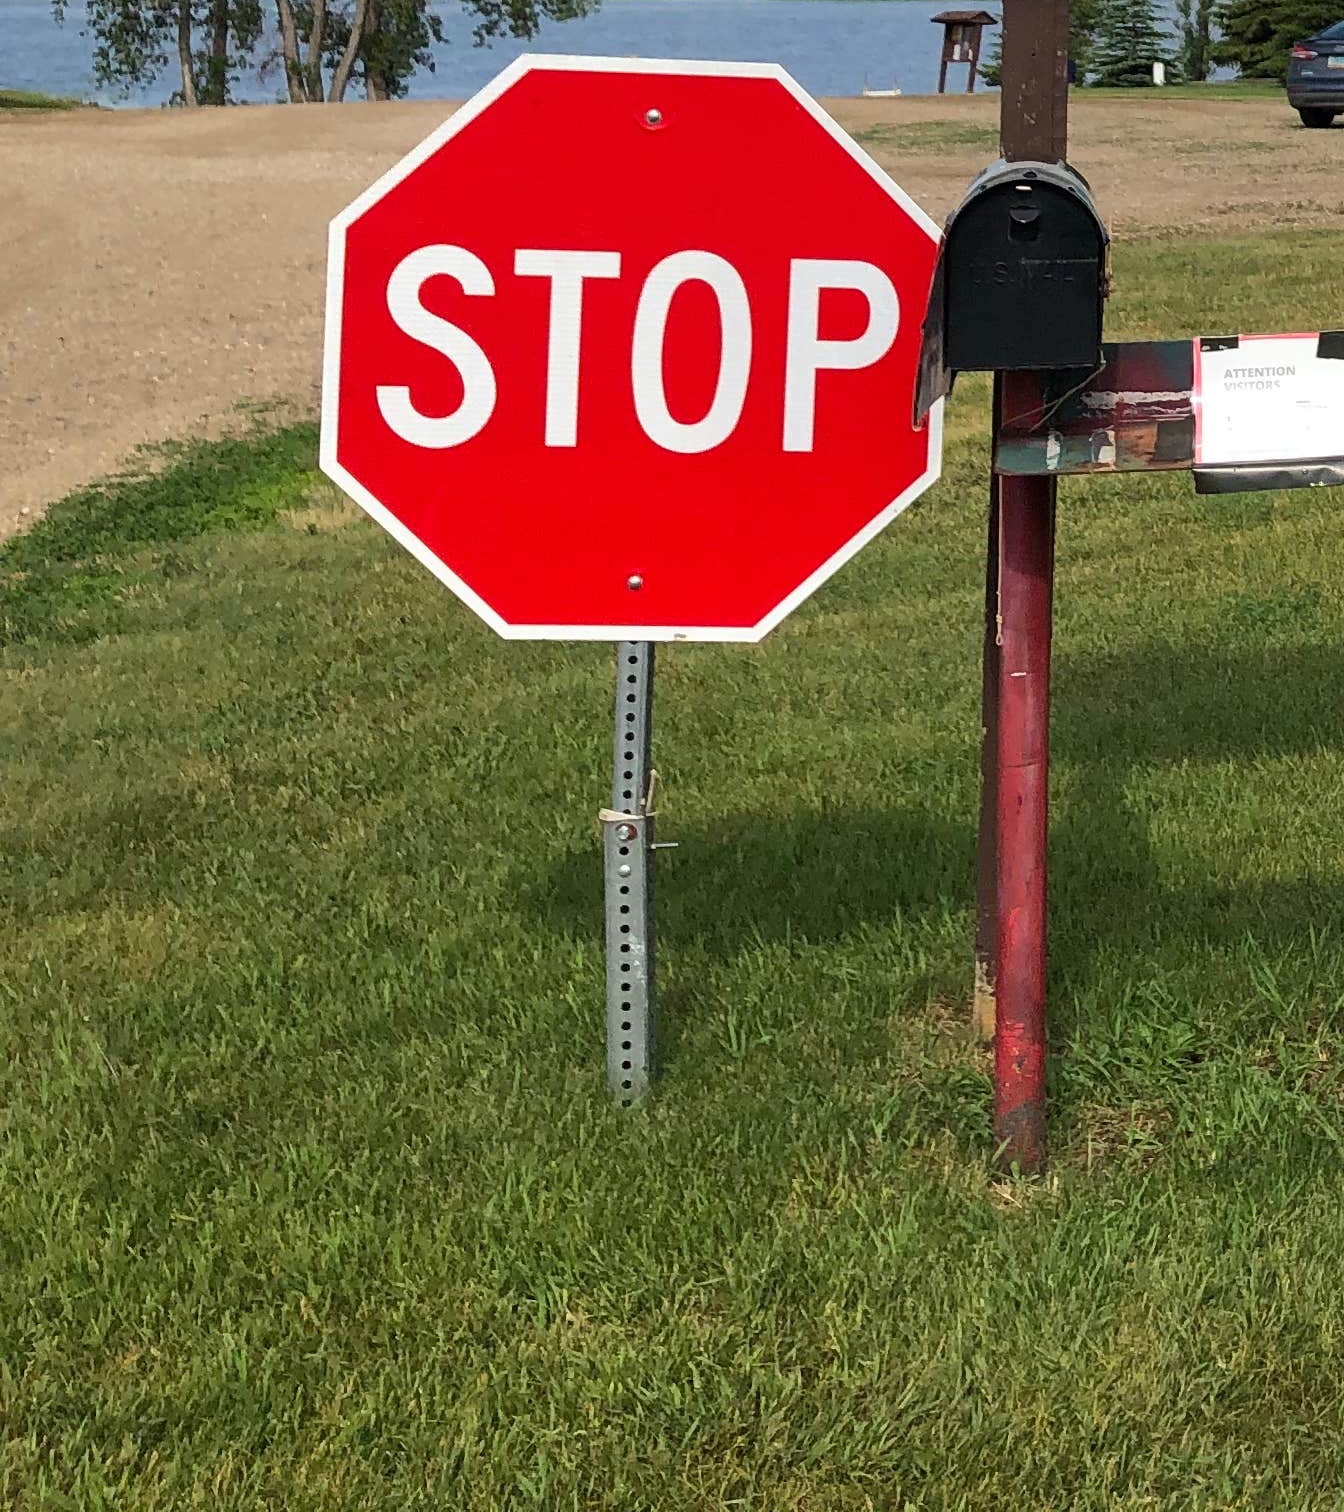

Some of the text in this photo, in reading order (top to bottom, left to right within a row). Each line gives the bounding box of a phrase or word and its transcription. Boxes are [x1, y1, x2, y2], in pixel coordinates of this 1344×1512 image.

[377, 246, 898, 452] STOP
[1223, 366, 1296, 379] ATTENTION
[1223, 380, 1281, 391] VISITORS
